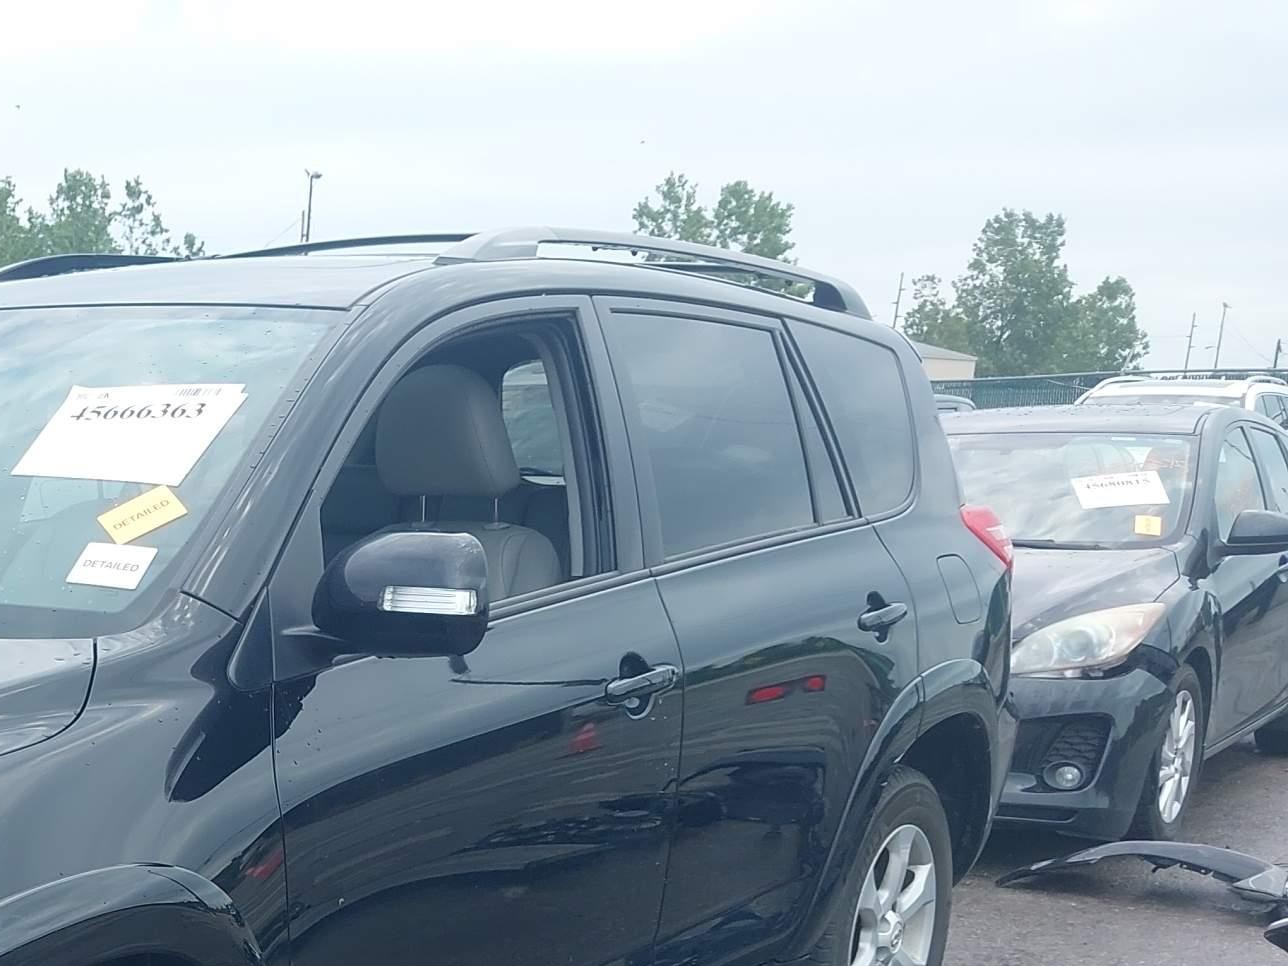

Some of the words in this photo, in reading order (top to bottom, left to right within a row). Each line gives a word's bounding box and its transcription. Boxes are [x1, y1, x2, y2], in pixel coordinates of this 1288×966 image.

[70, 402, 206, 422] 45666363
[112, 499, 171, 531] DETAILED
[82, 558, 140, 573] DETAILED
